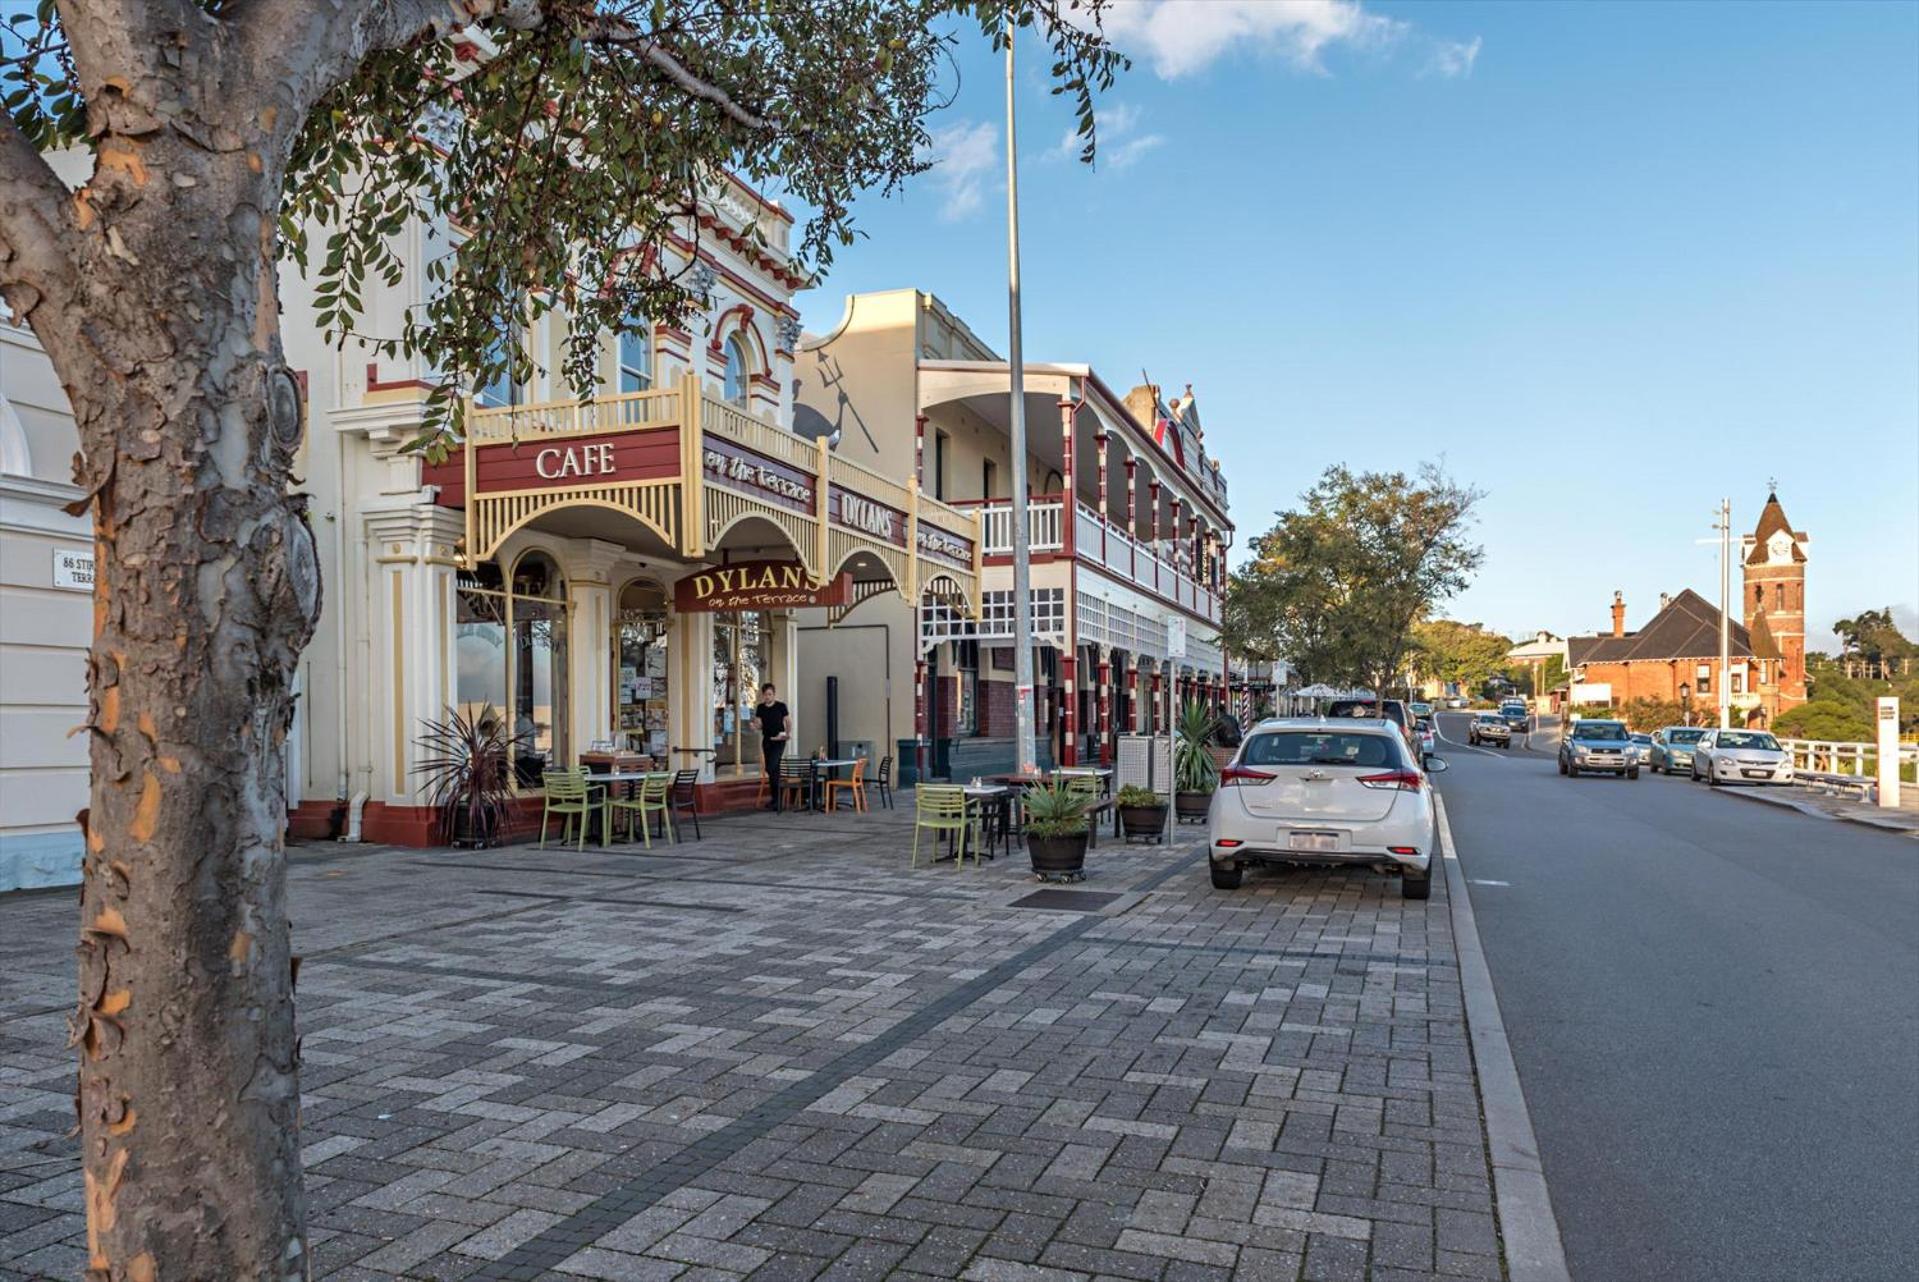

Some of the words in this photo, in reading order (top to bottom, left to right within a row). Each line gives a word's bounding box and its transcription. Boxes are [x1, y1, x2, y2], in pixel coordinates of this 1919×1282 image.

[536, 443, 615, 478] CAFE
[705, 451, 727, 474] on
[728, 456, 755, 481] the
[841, 494, 893, 539] DYLANS
[708, 597, 725, 607] on
[728, 595, 749, 606] the
[752, 593, 807, 605] Terrace
